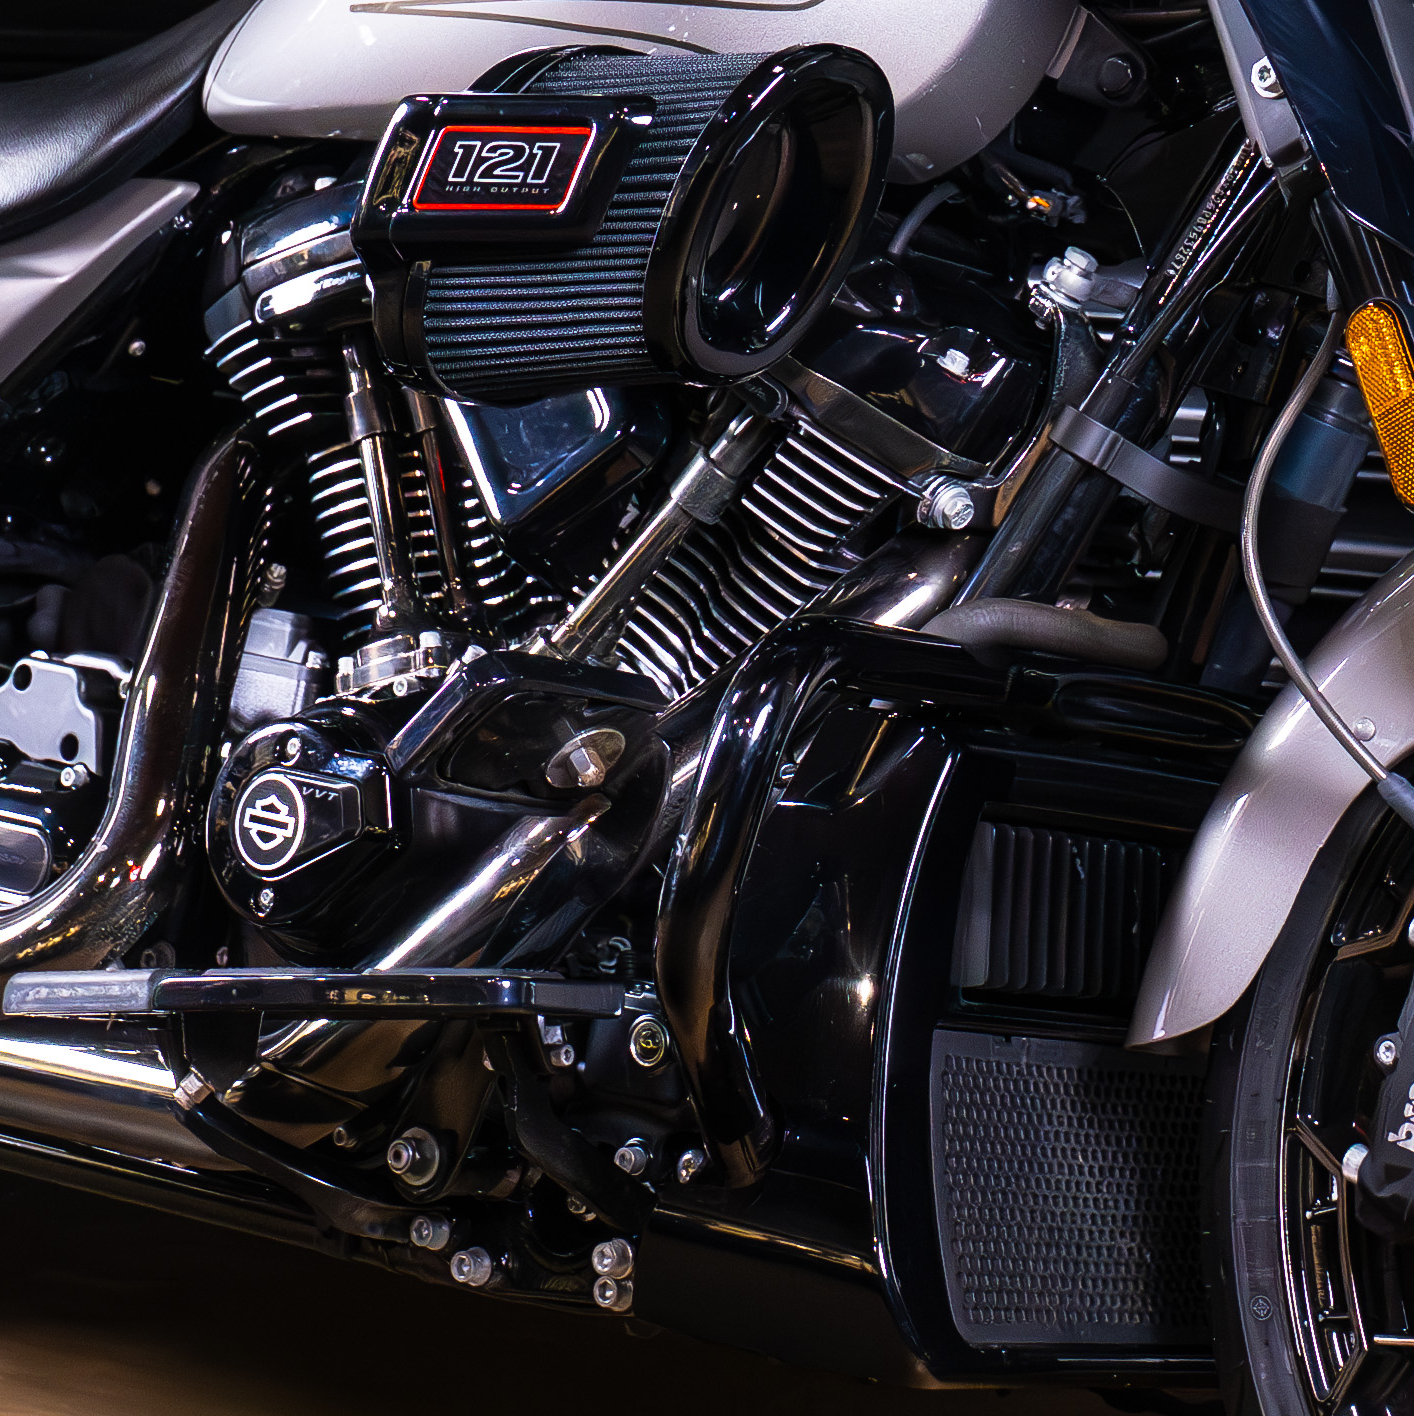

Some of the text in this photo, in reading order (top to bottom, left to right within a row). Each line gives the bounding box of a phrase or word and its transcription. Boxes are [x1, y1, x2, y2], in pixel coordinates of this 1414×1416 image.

[447, 140, 562, 184] 121
[445, 185, 550, 195] HIGH OUTPUT
[302, 786, 339, 801] VVT
